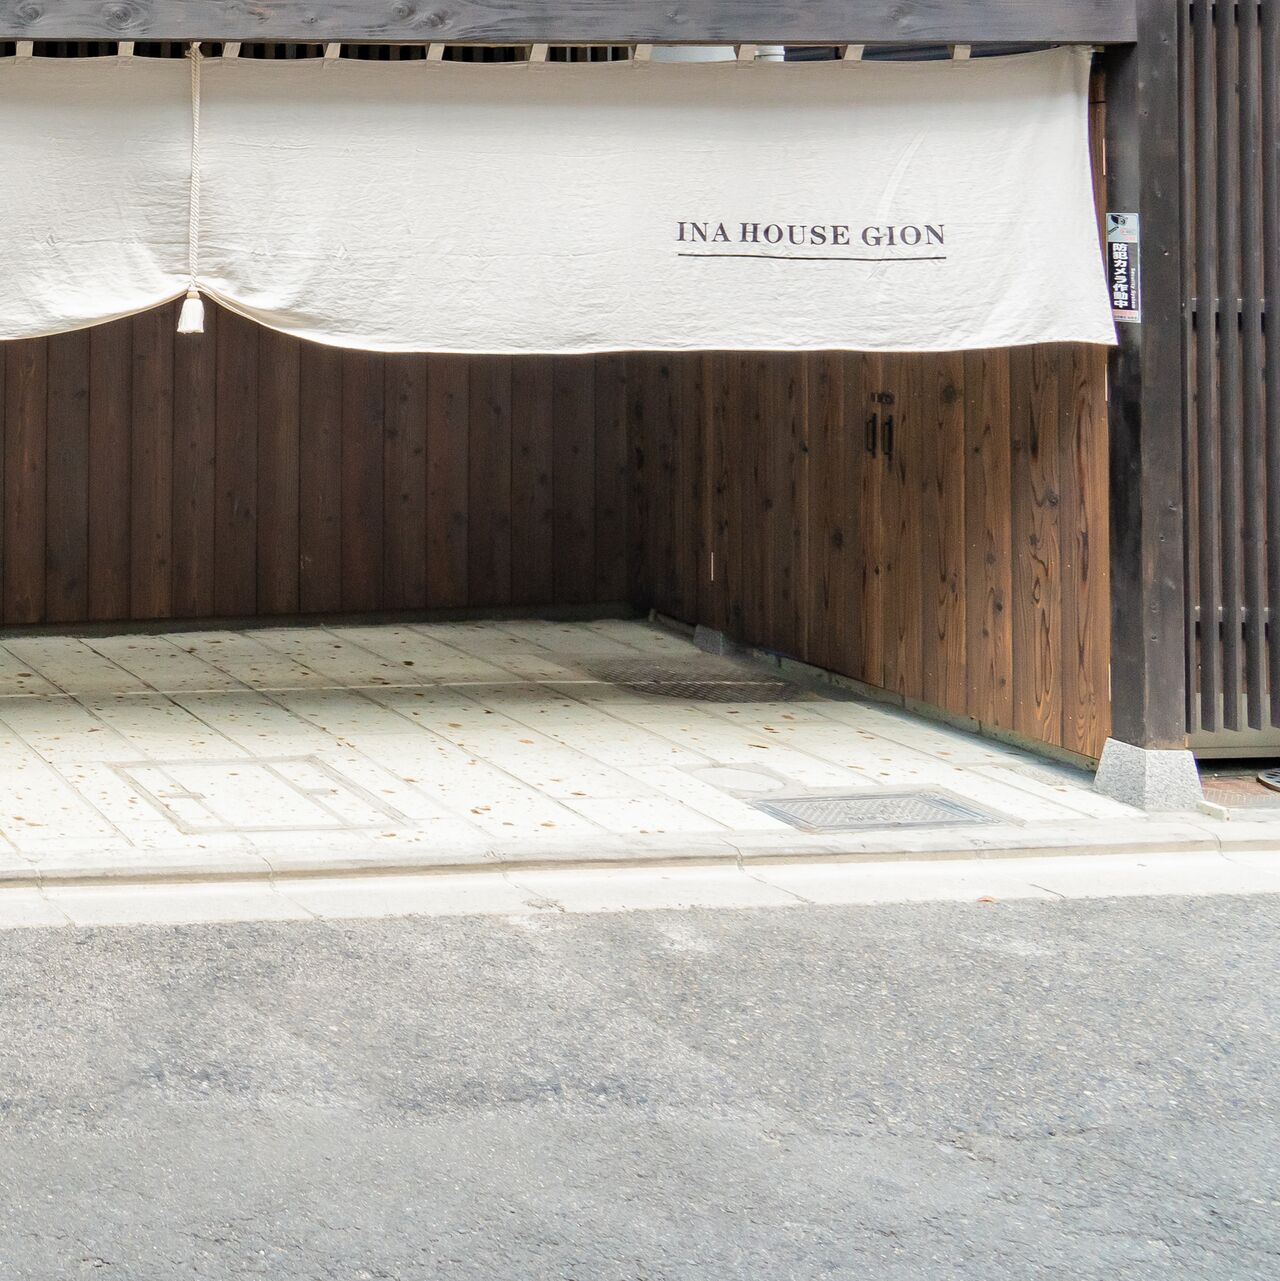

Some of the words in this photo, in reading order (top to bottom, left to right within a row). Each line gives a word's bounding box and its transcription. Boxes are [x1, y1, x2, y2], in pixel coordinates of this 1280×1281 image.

[676, 221, 732, 243] INA
[739, 222, 851, 246] HOUSE
[861, 224, 946, 247] GION
[1112, 242, 1129, 309] 防犯カメラ作動中
